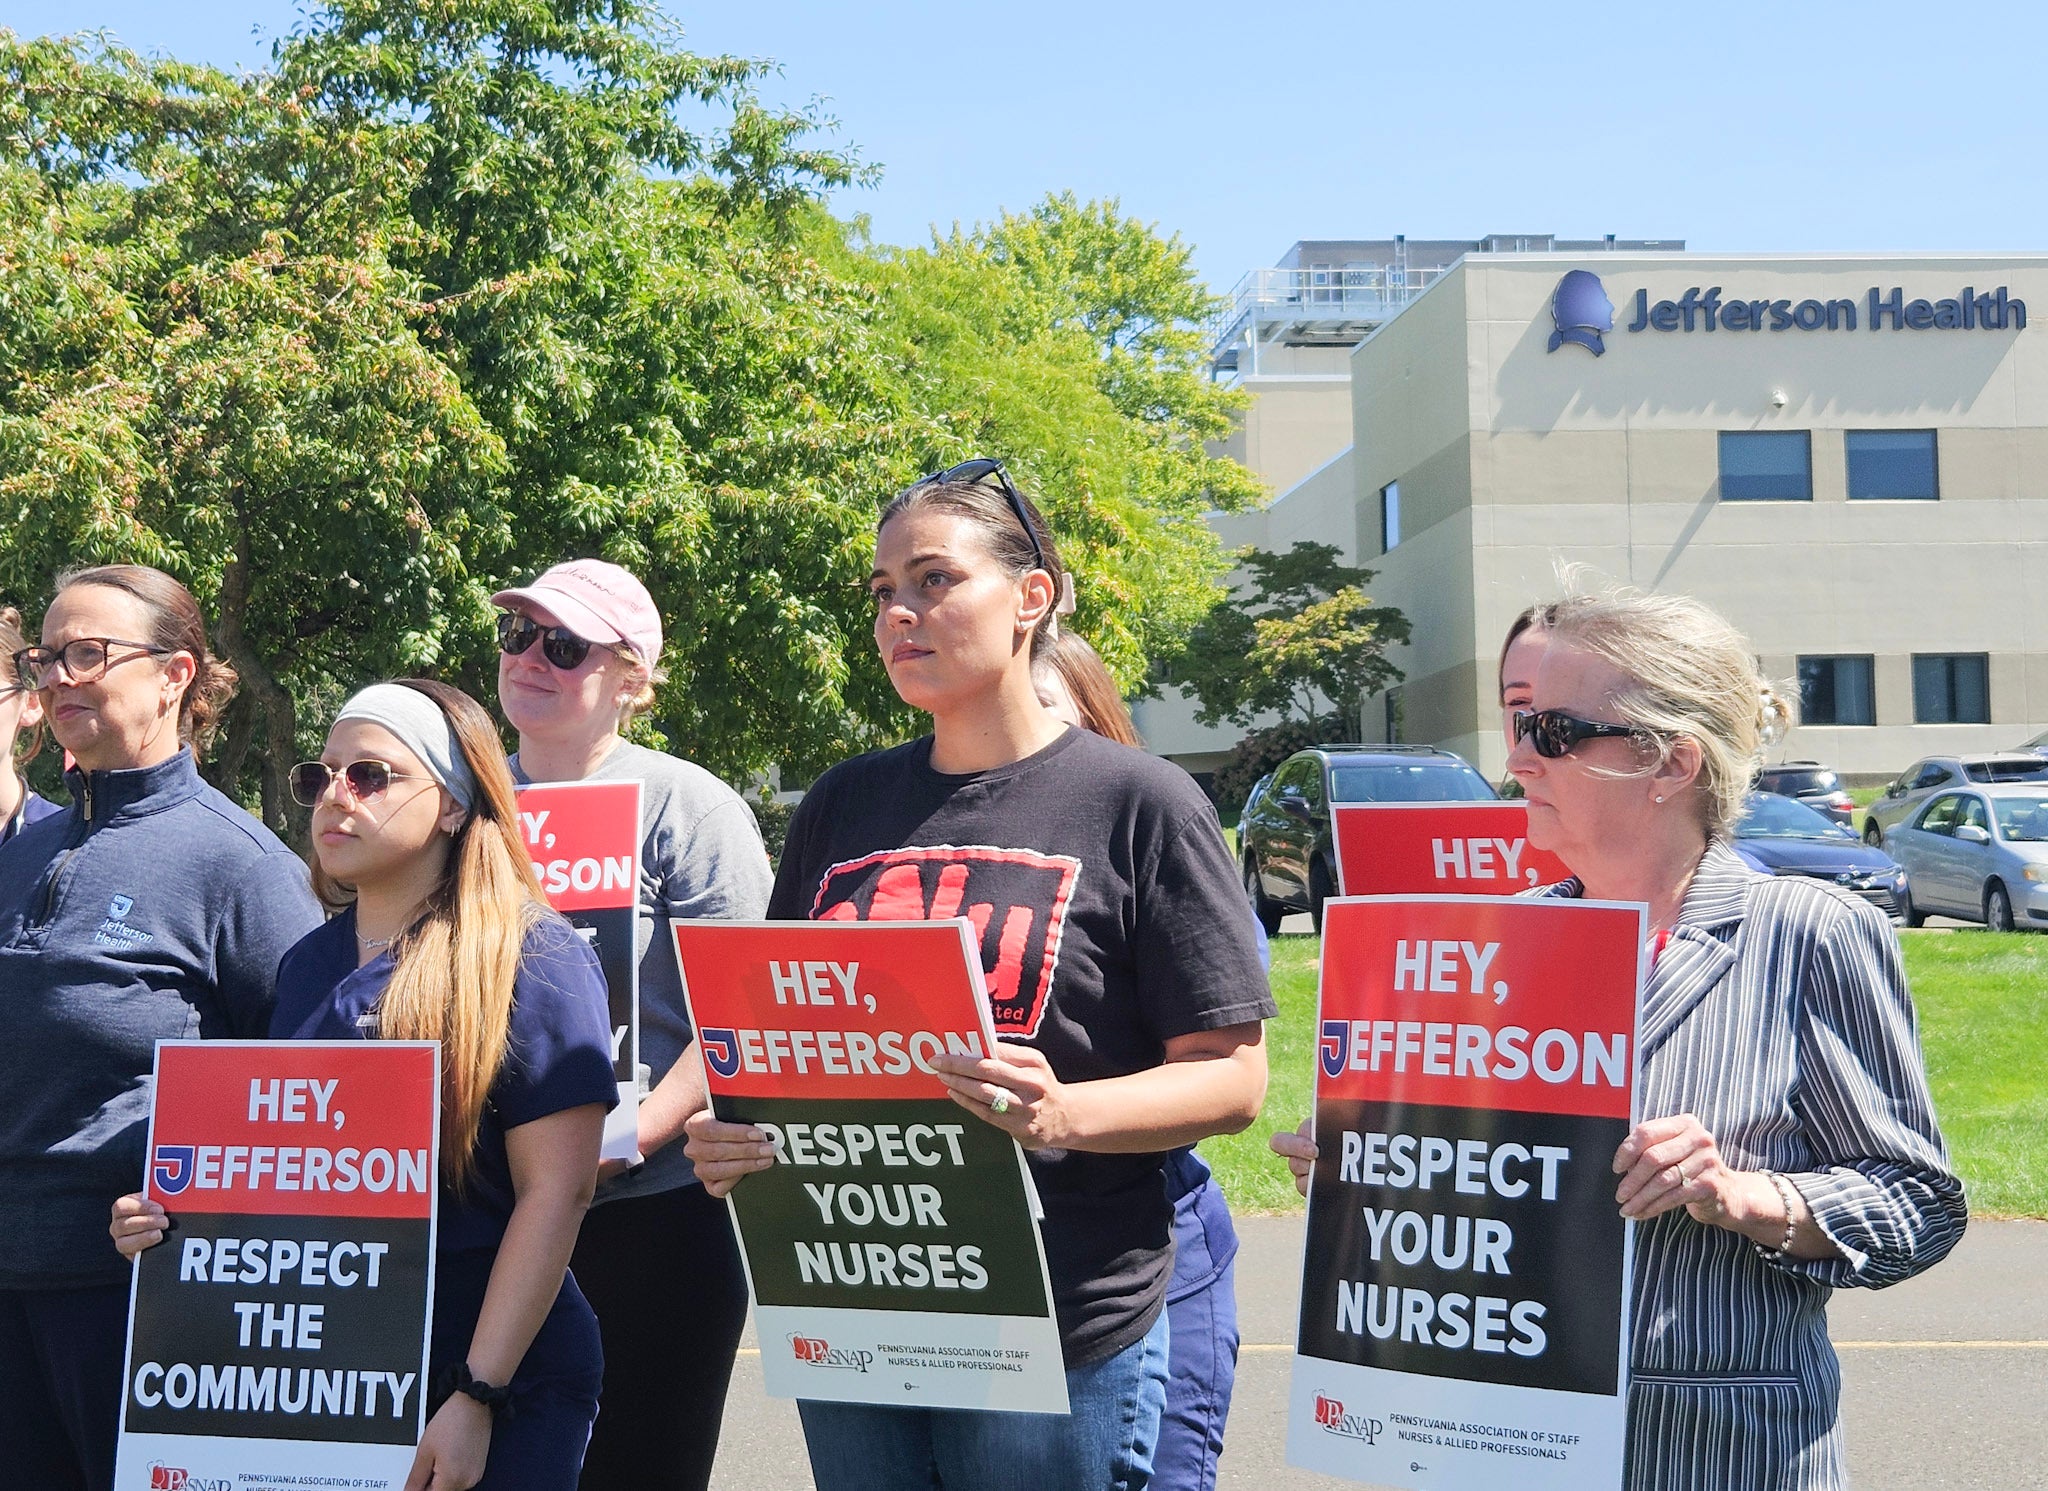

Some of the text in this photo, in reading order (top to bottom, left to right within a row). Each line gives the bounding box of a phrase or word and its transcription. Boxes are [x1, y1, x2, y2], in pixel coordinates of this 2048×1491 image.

[1628, 287, 2027, 333] Jefferson Health
[1431, 838, 1538, 885] HEY,
[94, 931, 133, 950] Health
[101, 918, 154, 943] Jefferson
[769, 961, 877, 1014] HEY,
[1394, 939, 1508, 1005] HEY,
[700, 1026, 984, 1078] JEFFERSON
[1321, 1020, 1626, 1087] JEFFERSON
[248, 1078, 345, 1131] HEY,
[754, 1123, 966, 1166] RESPECT
[1340, 1130, 1569, 1200] RESPECT
[154, 1145, 428, 1195] JEFFERSON
[803, 1183, 948, 1226] YOUR
[180, 1237, 389, 1287] RESPECT
[1363, 1206, 1512, 1274] YOUR
[794, 1242, 989, 1290] NURSES
[234, 1302, 324, 1349] THE
[1336, 1279, 1547, 1357] NURSES
[877, 1344, 1030, 1359] PENNSYLVANIA ASSOCIATION OF STAFF
[888, 1358, 920, 1367] NURSES
[928, 1359, 955, 1369] ALLIED
[957, 1361, 1023, 1372] PROFESSIONALS
[134, 1361, 416, 1418] COMMUNITY
[1389, 1413, 1580, 1445] PENNSYLVANIA ASSOCIATION OF STAFF
[1398, 1430, 1567, 1460] NURSES & ALLIED PROFESSIONALS
[238, 1473, 389, 1489] PENNSYLVANIA ASSOCIATION OF STAFF
